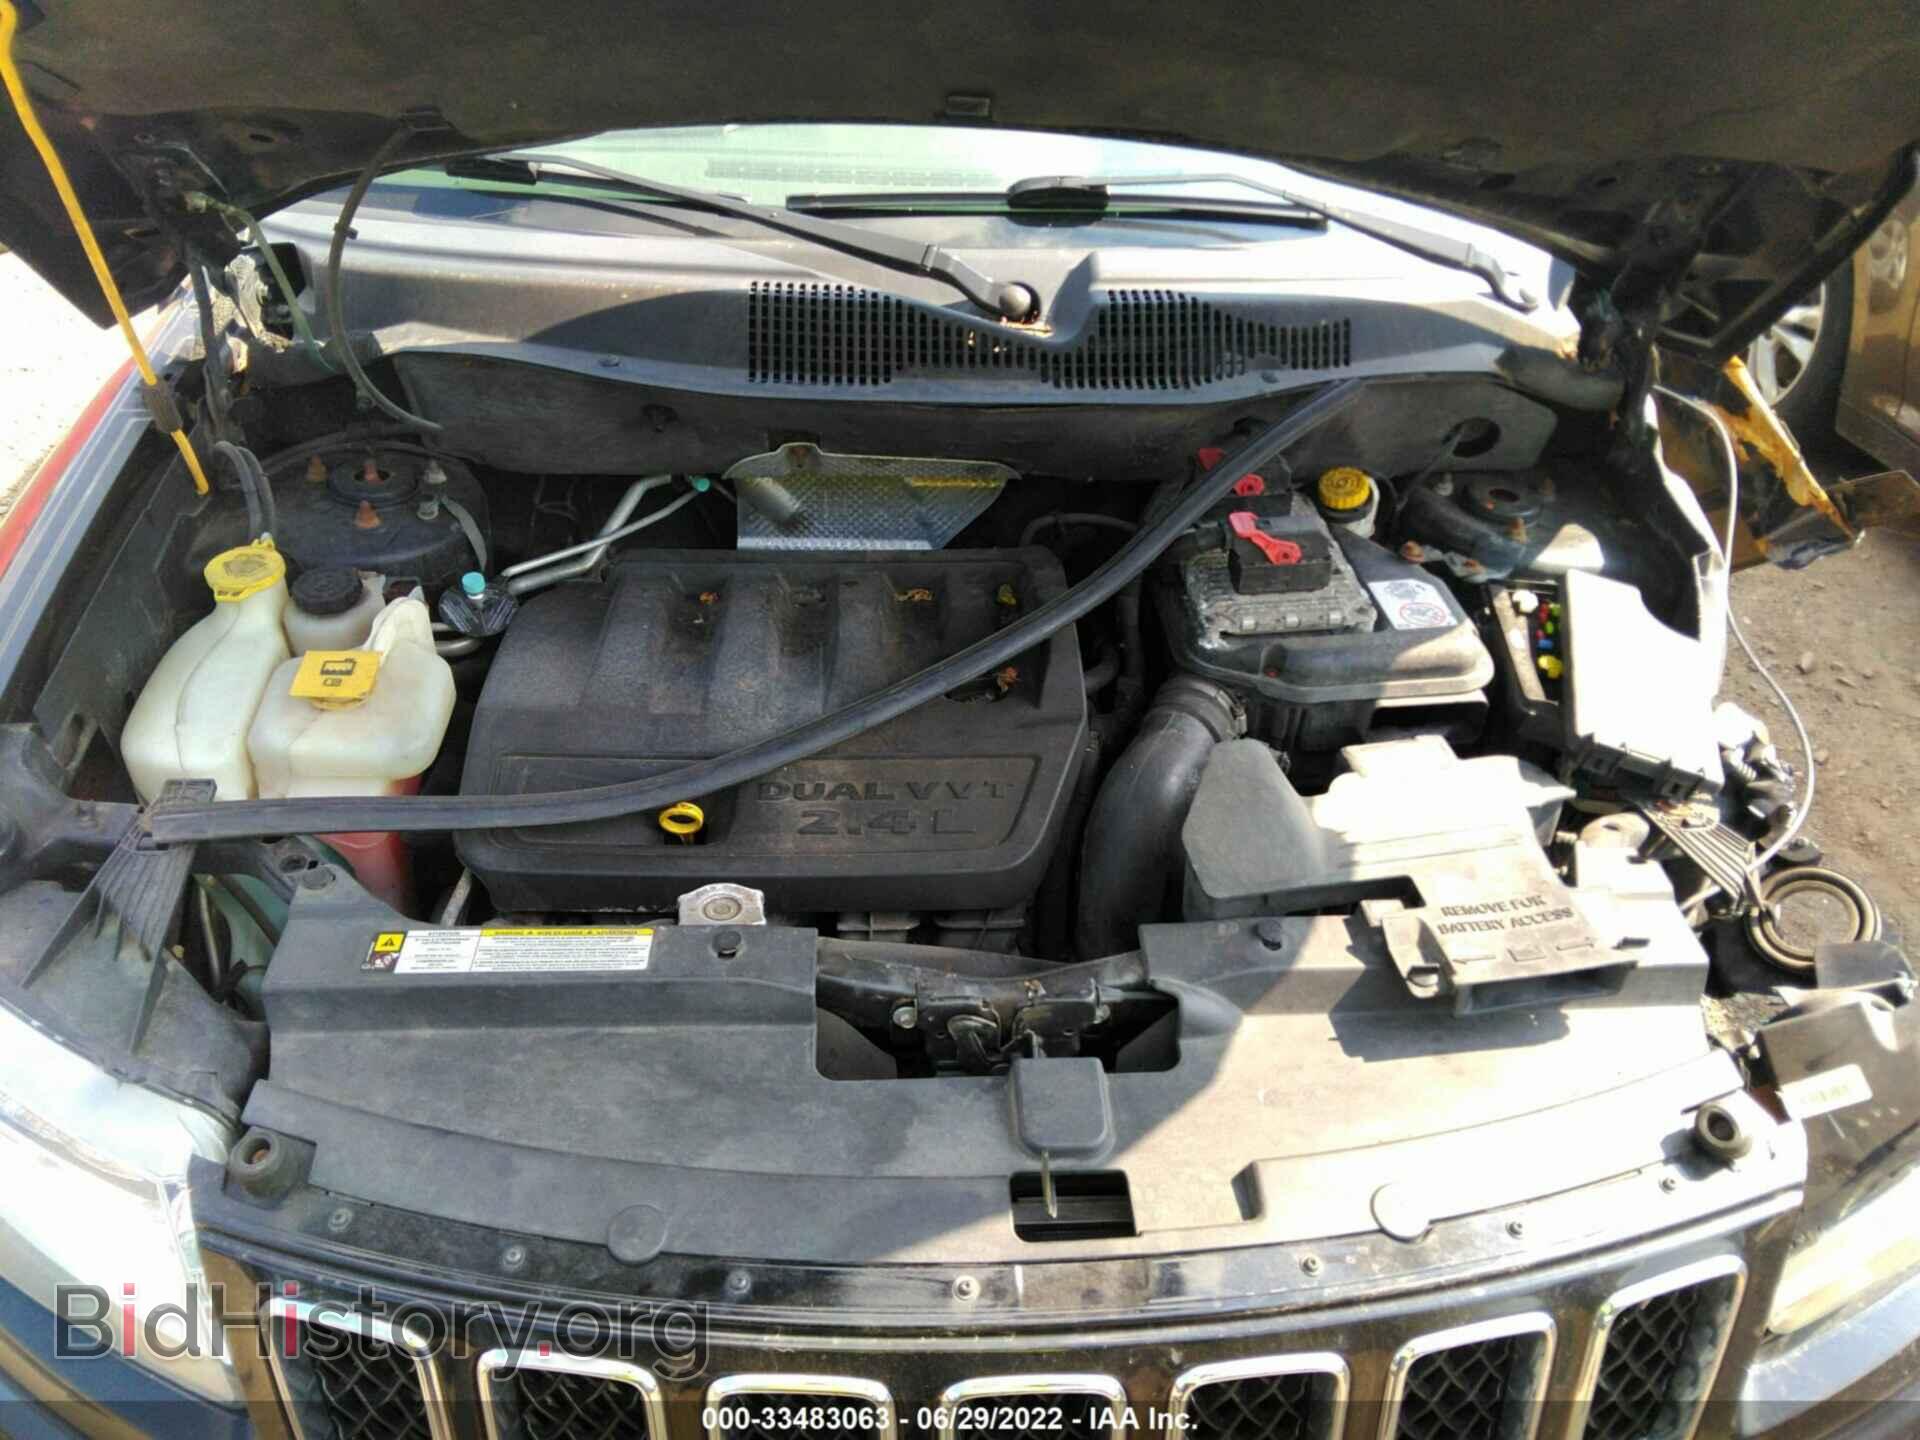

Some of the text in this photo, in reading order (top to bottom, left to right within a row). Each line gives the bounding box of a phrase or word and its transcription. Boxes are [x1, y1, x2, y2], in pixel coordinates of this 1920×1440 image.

[758, 780, 1015, 801] DUAL VVT
[796, 809, 977, 836] 2.4L
[1437, 907, 1574, 935] BATTERY ACCESS
[1441, 901, 1509, 917] REMOVE
